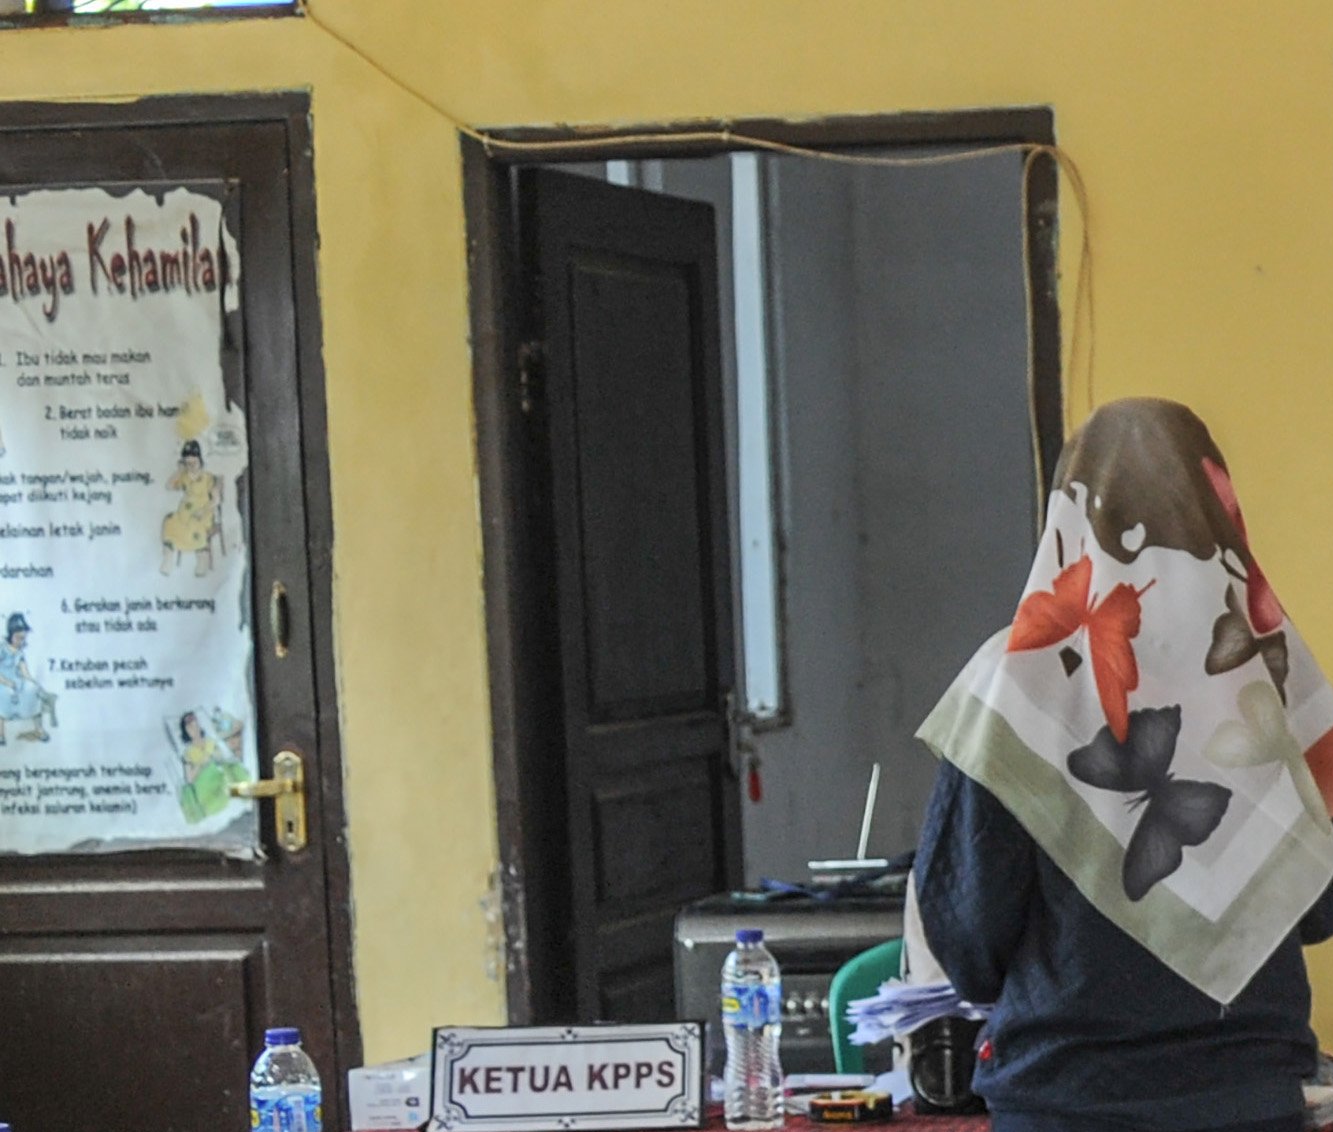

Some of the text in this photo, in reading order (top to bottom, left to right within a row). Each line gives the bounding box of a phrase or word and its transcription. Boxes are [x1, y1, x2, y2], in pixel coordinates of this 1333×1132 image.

[45, 349, 79, 366] tidak
[110, 348, 151, 365] makan
[17, 371, 130, 388] dan muntah terus
[44, 405, 57, 420] 2.
[60, 404, 92, 420] Berat
[95, 403, 131, 419] badan
[60, 425, 90, 440] tidak
[49, 521, 84, 538] letak
[88, 520, 122, 541] janin
[124, 596, 153, 617] janin
[155, 596, 216, 615] berkurang
[456, 1060, 677, 1097] KETUA KPPS
